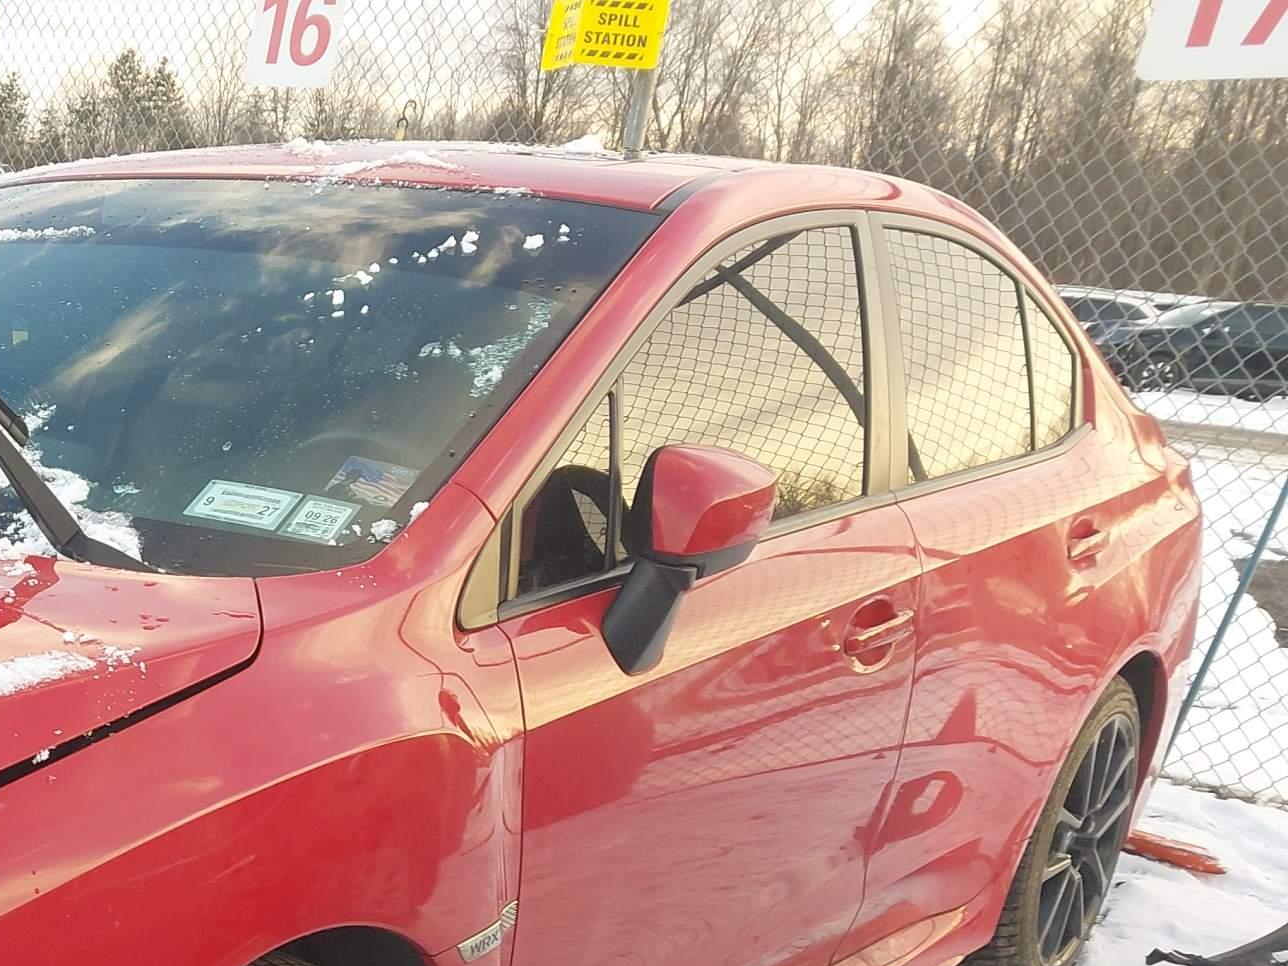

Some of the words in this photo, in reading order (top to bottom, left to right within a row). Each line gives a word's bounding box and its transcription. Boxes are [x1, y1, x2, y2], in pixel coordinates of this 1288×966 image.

[598, 12, 640, 28] SPILL
[263, 0, 336, 66] 16
[583, 30, 648, 48] STATION
[203, 496, 215, 506] 9
[256, 505, 280, 517] 27
[305, 510, 322, 521] 09
[322, 514, 340, 524] 26
[470, 930, 499, 954] WRX
